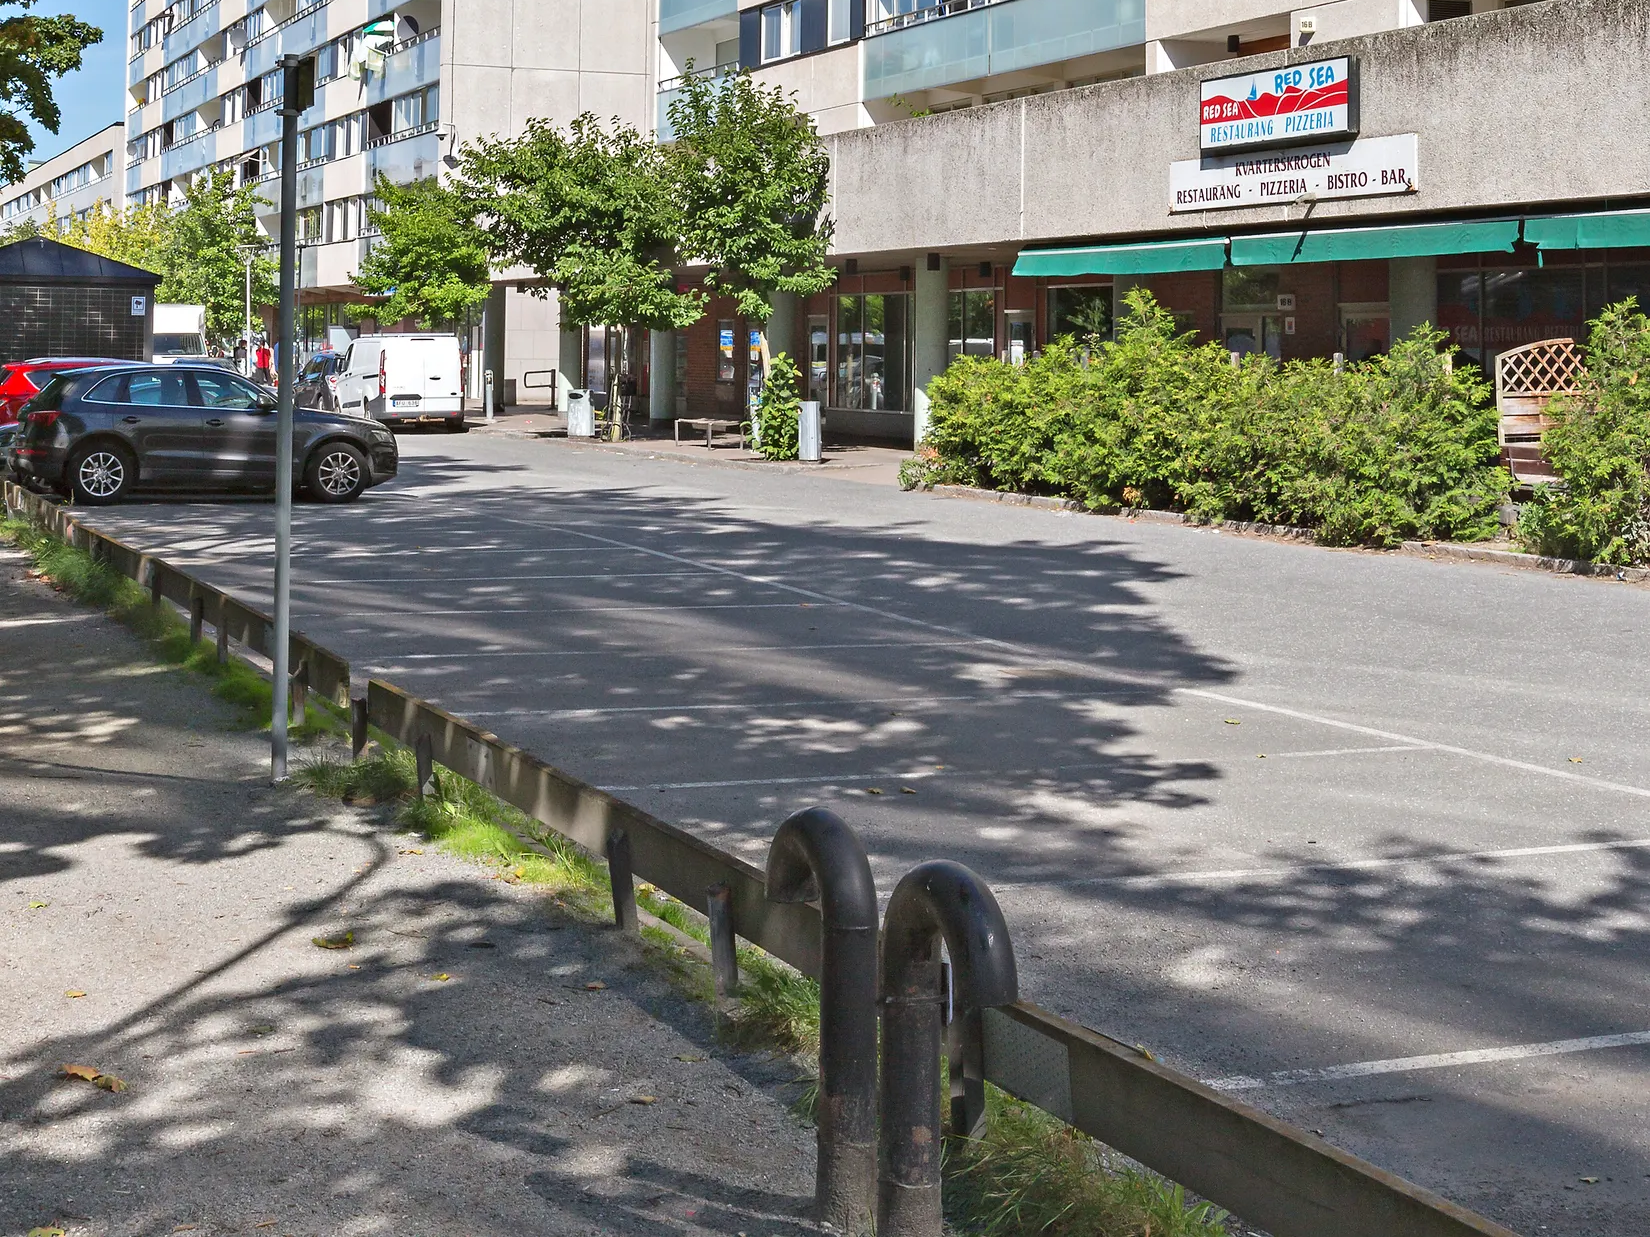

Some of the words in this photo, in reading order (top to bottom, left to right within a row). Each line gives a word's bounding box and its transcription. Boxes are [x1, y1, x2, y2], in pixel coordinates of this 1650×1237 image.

[1274, 70, 1302, 94] RED
[1309, 65, 1335, 89] SEA
[1203, 104, 1220, 120] RED
[1222, 102, 1238, 118] SEA
[1210, 119, 1273, 143] RESTAURANG
[1285, 111, 1333, 133] PIZZERIA
[1235, 152, 1331, 176] KVARTERSKROGEN
[1176, 184, 1241, 204] RESTAURANG
[1260, 178, 1307, 196] PIZZERIA
[1327, 171, 1368, 190] BISTRO
[1381, 168, 1410, 185] BAR
